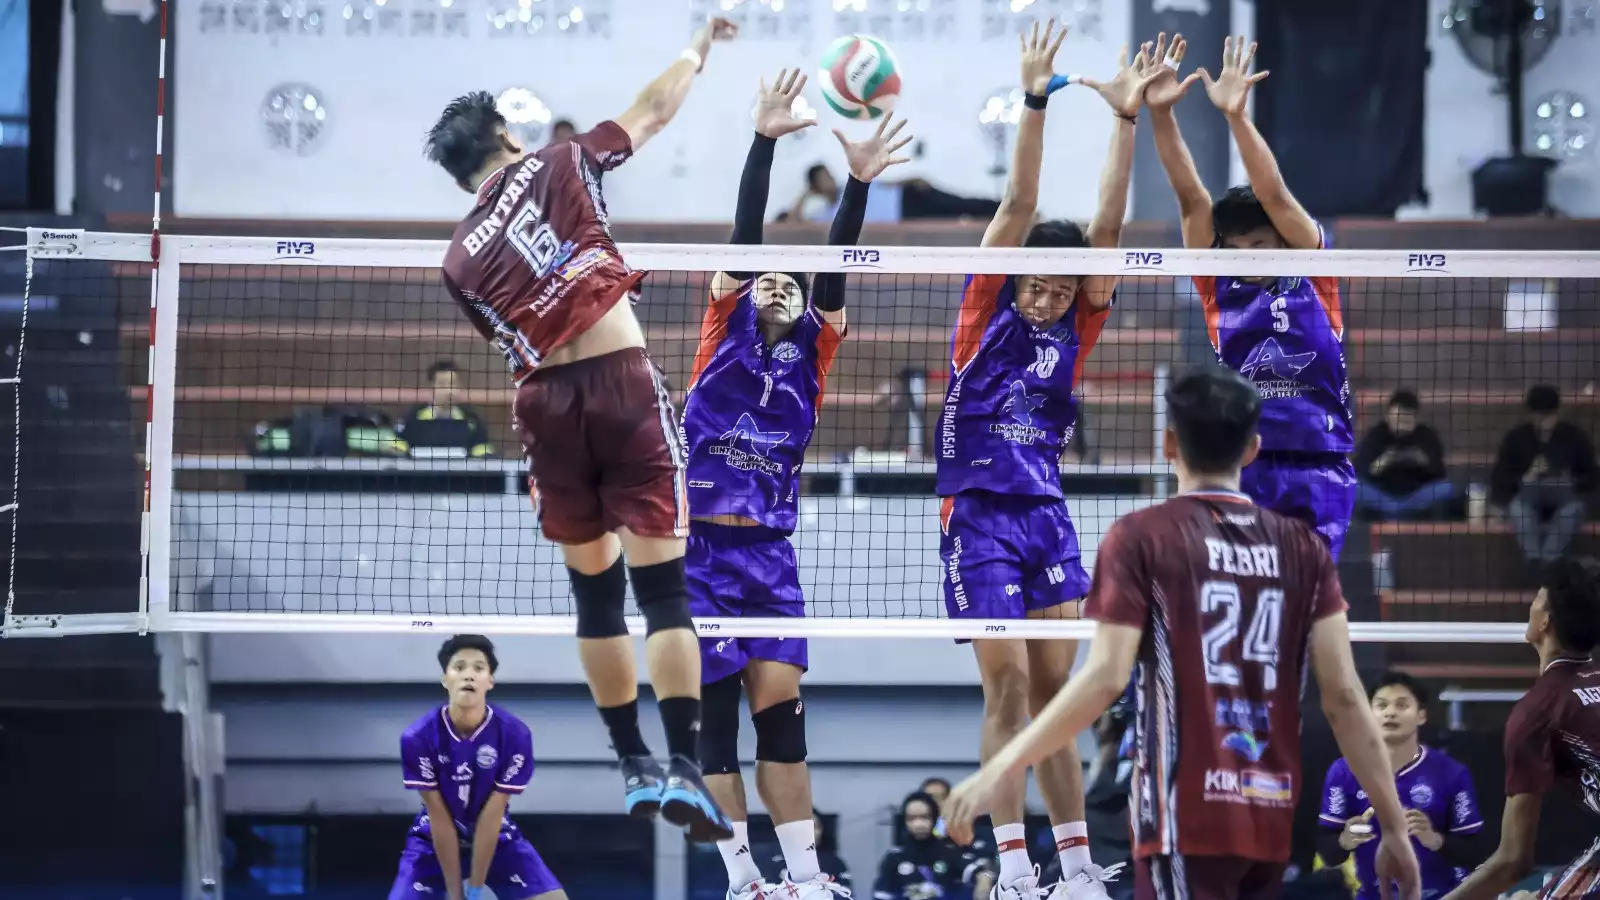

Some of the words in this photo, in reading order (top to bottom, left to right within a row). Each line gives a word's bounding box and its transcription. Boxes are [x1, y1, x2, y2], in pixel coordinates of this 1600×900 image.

[50, 232, 78, 240] Senoh
[505, 200, 561, 279] 6
[276, 241, 315, 255] FIVB
[843, 249, 880, 263] FIVB
[1125, 252, 1163, 265] FIVB
[1408, 253, 1446, 267] FIVB
[557, 279, 578, 298] Online
[759, 374, 774, 408] 1
[942, 405, 957, 459] BHAGASASI
[708, 445, 748, 462] BINTANG
[1204, 537, 1280, 578] FEBRI
[954, 583, 970, 612] TIRTA
[411, 620, 433, 628] FIVB
[699, 623, 720, 631] FIVB
[1200, 580, 1285, 692] 24
